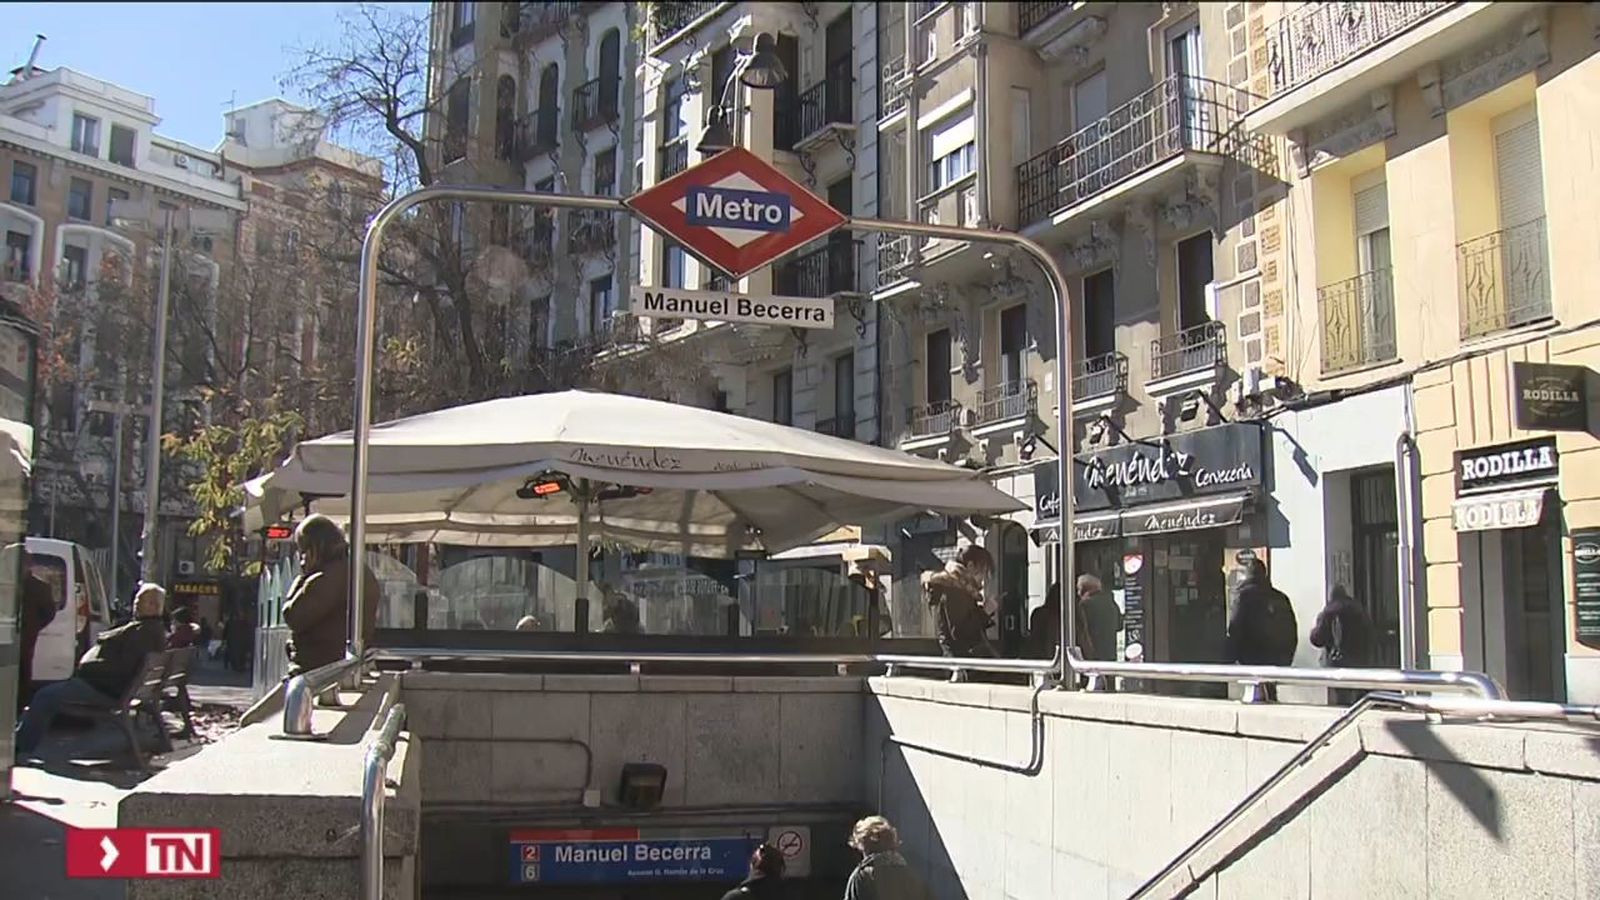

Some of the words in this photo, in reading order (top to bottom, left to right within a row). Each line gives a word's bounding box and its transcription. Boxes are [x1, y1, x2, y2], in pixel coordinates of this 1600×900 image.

[696, 192, 782, 224] Metro
[644, 292, 729, 316] Manuel
[737, 298, 826, 322] Becerra
[1523, 389, 1580, 402] RODILLA
[1461, 446, 1554, 481] RODILLA
[525, 846, 536, 860] 2
[555, 845, 628, 863] Manuel
[635, 844, 712, 862] Becerra
[525, 865, 535, 880] 6
